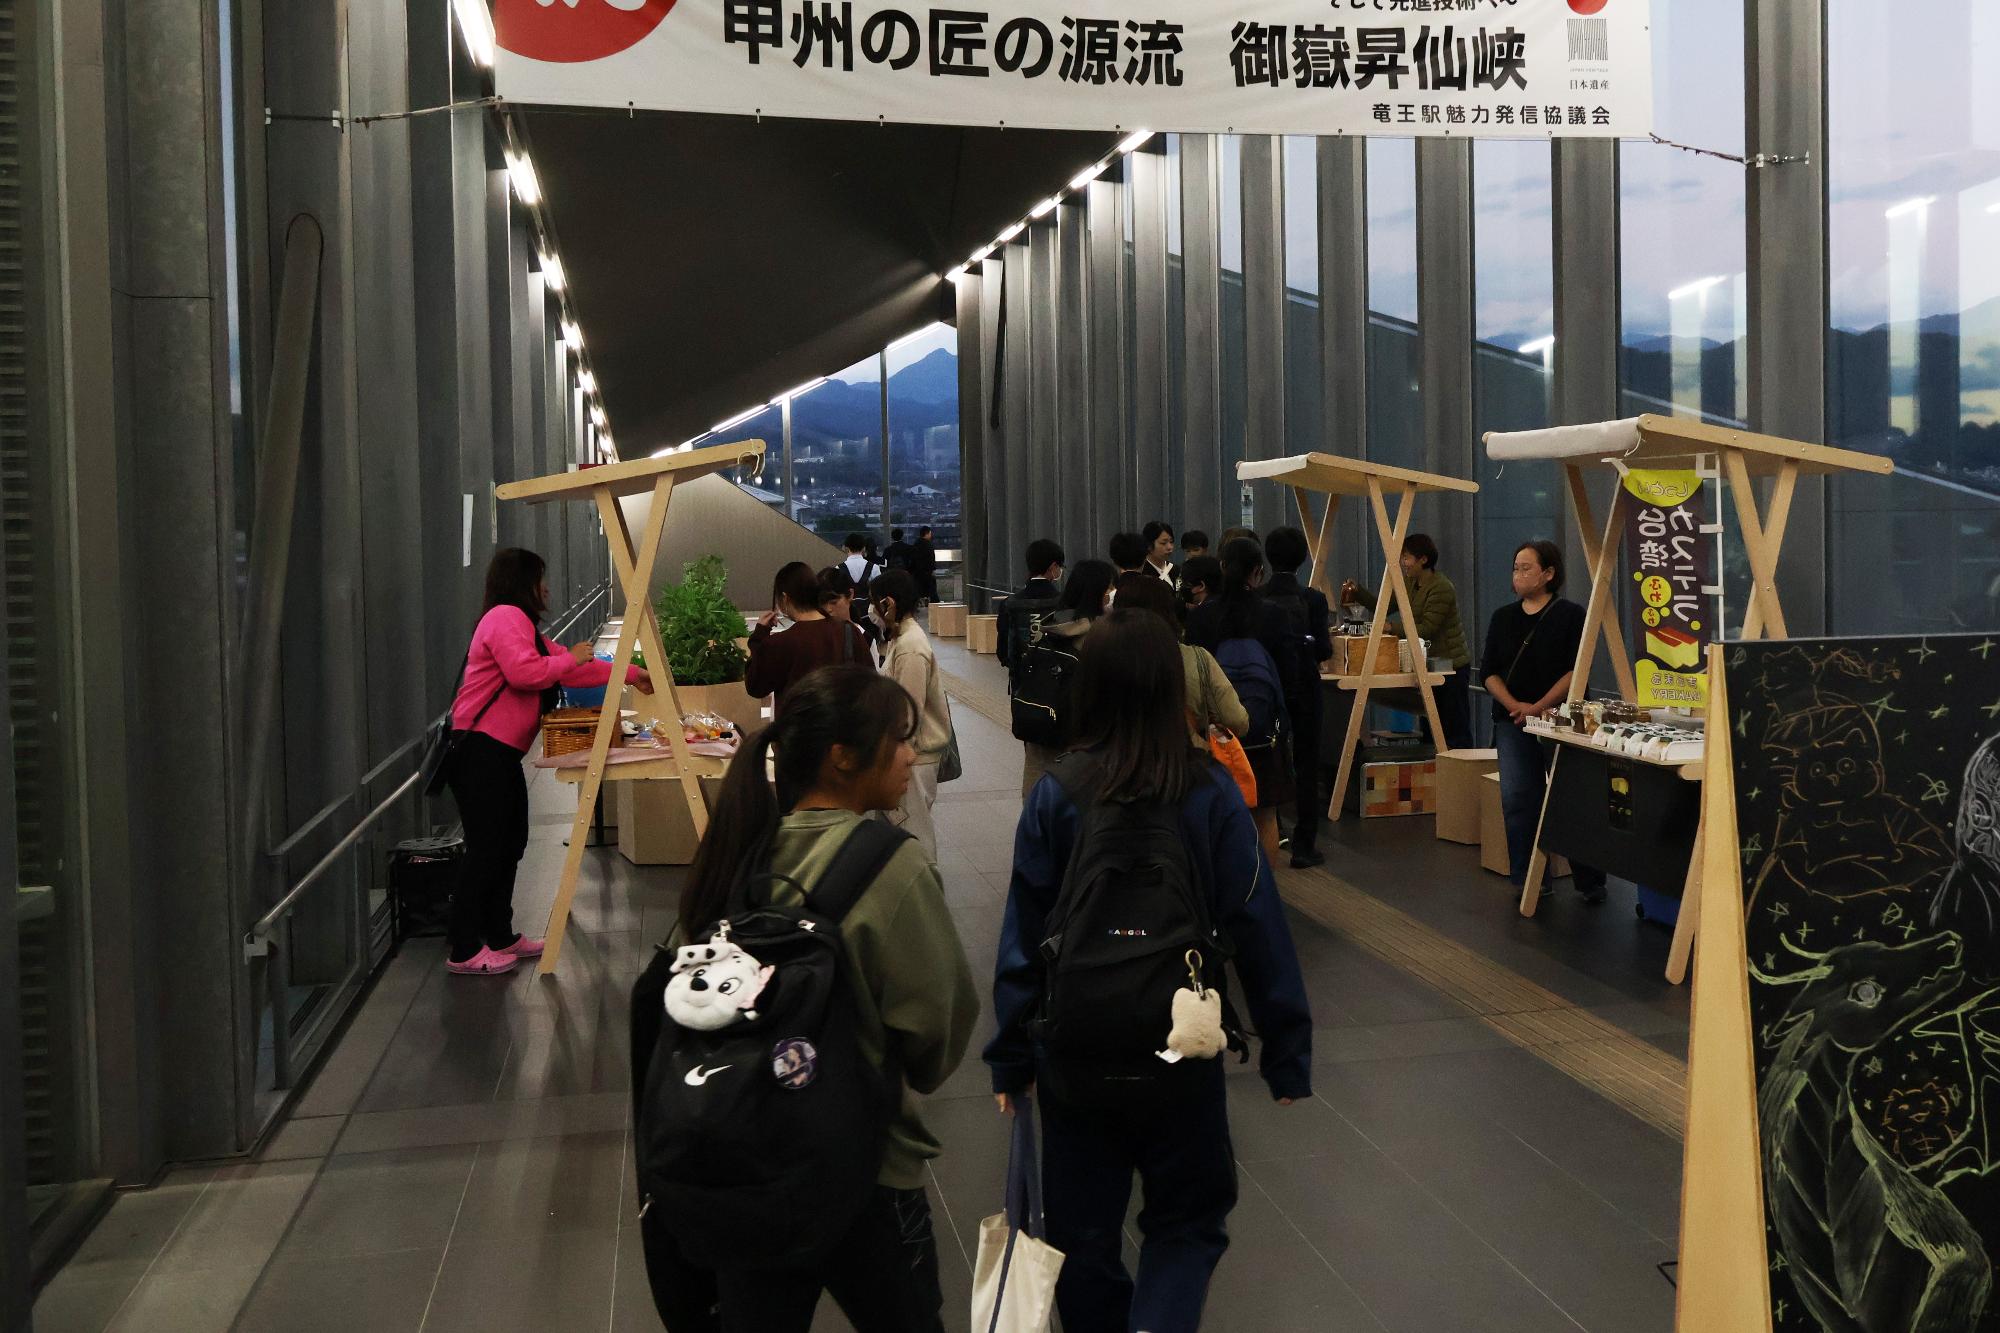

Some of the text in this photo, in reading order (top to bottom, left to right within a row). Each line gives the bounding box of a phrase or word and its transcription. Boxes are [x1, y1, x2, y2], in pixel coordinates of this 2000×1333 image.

[724, 0, 1528, 91] 甲州の匠の源流 御嶽昇仙峡
[1570, 79, 1609, 90] 日本遺産
[1373, 103, 1611, 126] 竜王駅魅力発信協議会
